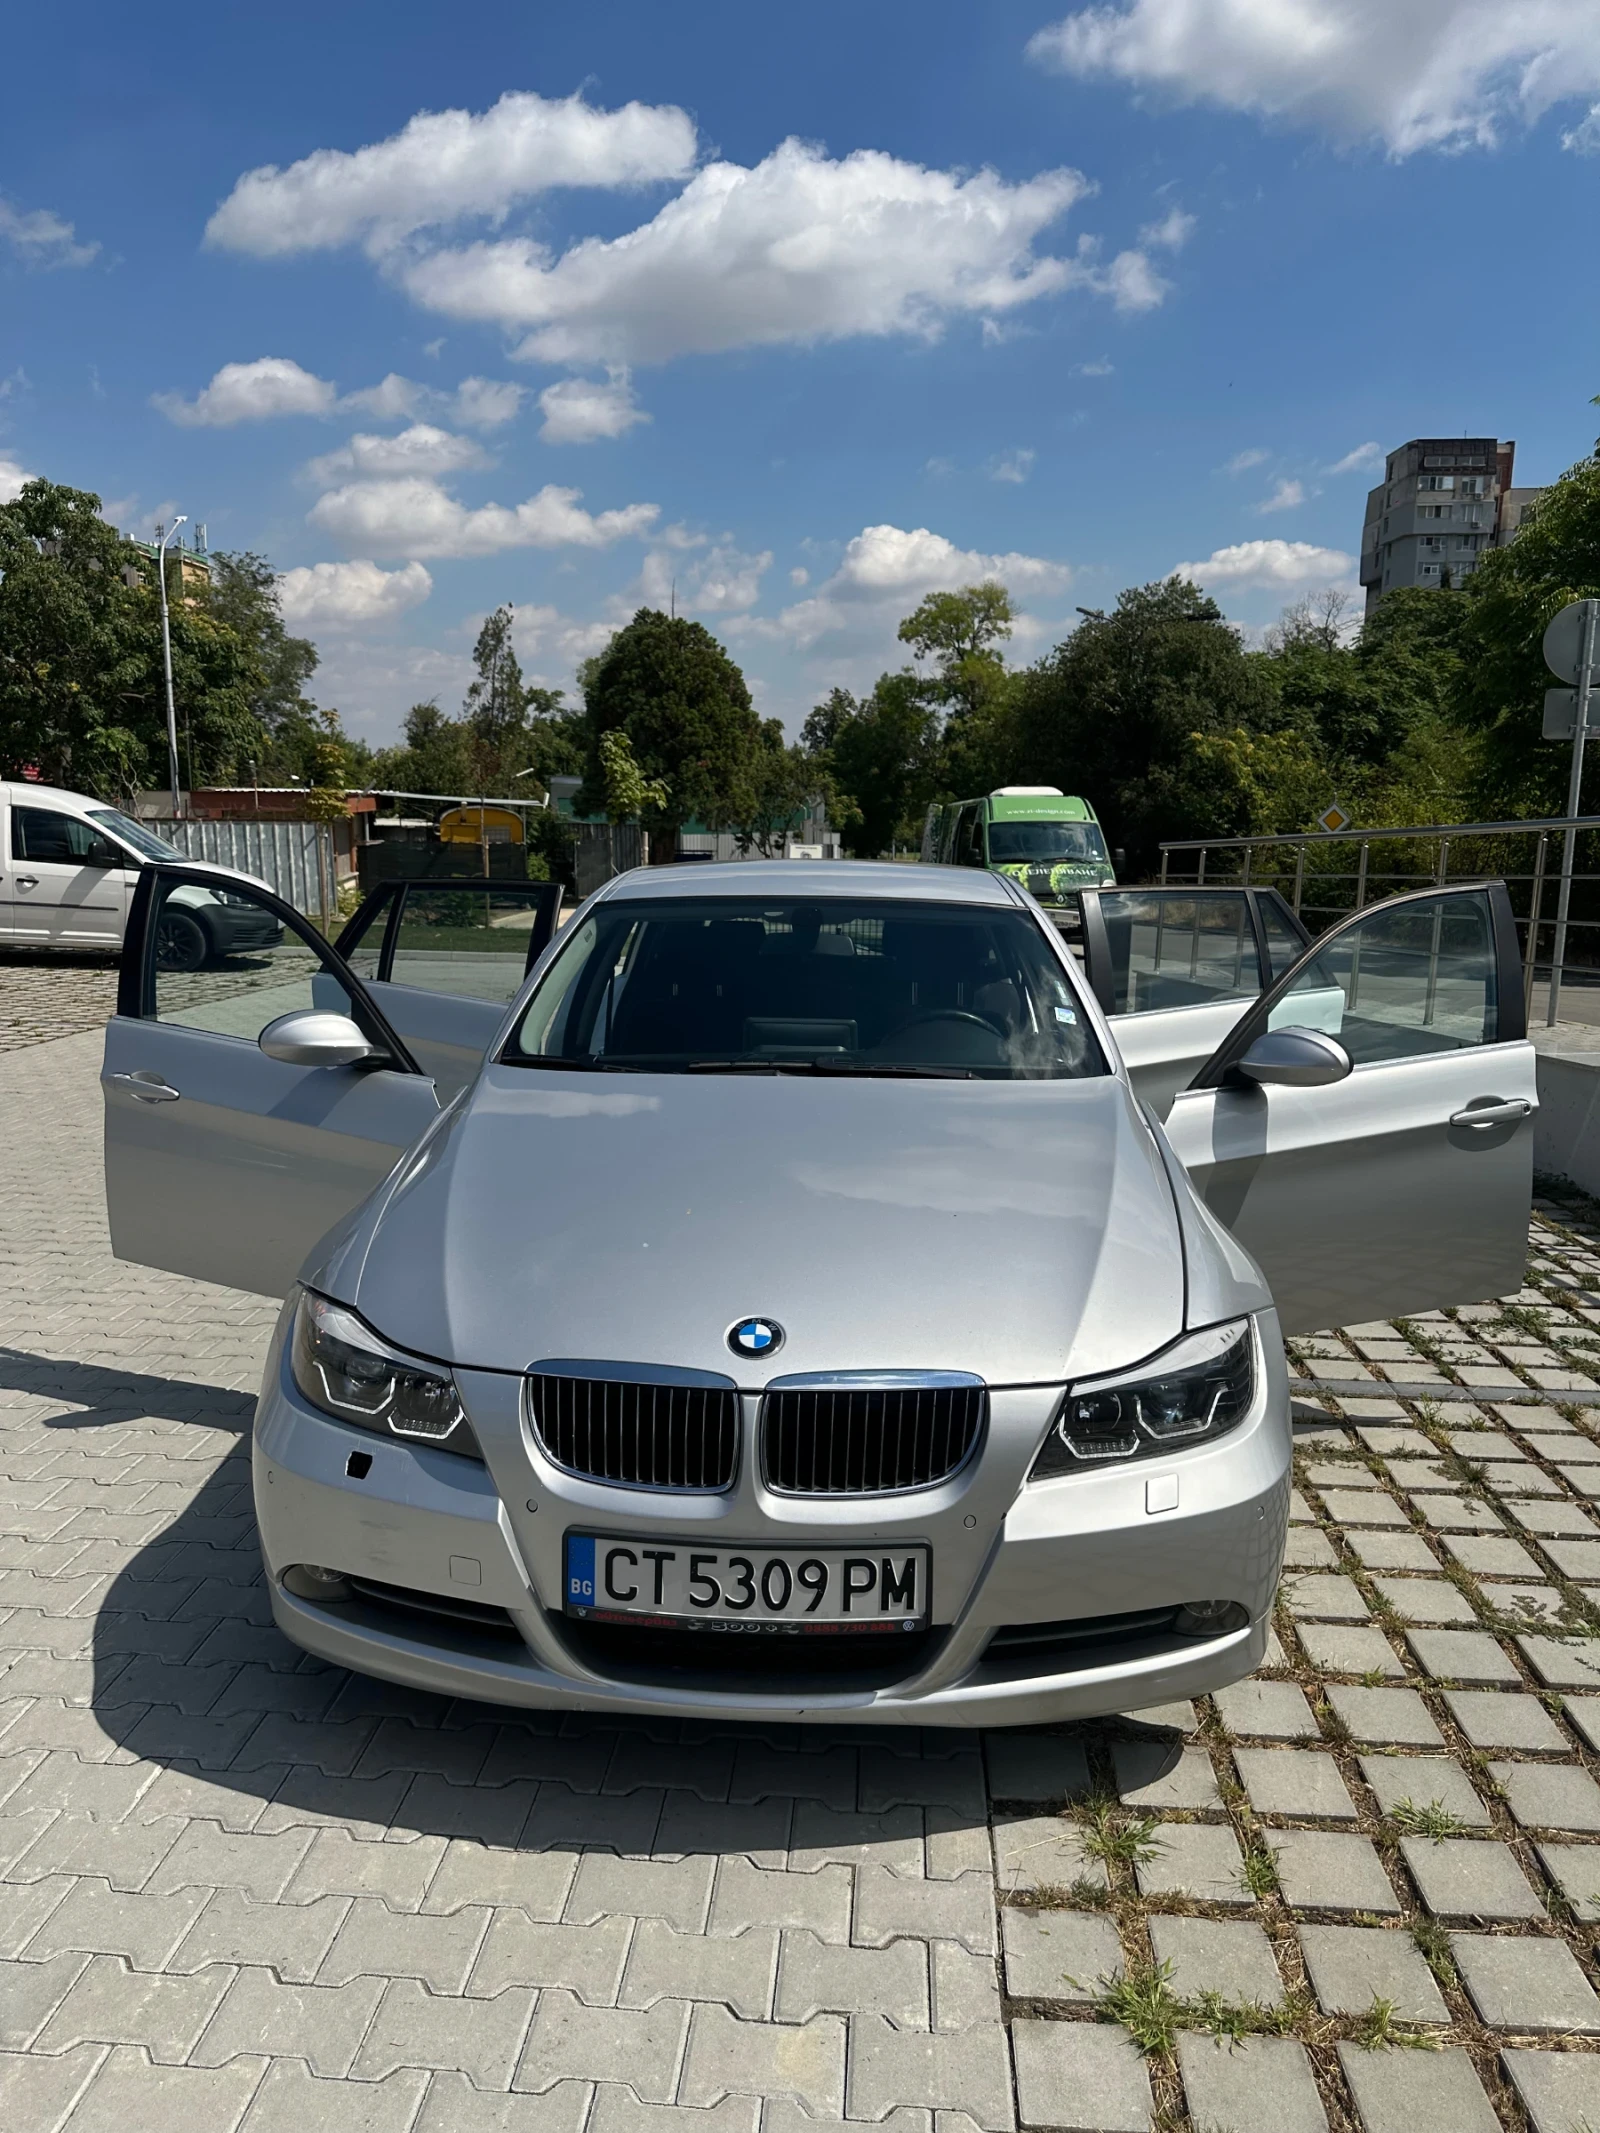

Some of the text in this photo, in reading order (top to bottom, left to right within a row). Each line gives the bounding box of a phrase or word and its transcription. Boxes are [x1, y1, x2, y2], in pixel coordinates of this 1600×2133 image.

[1012, 867, 1098, 877] ОЕЛЕЯВАНЕ
[736, 1318, 779, 1331] BMW
[571, 1577, 593, 1596] BG
[604, 1548, 916, 1612] CT 5309 PM
